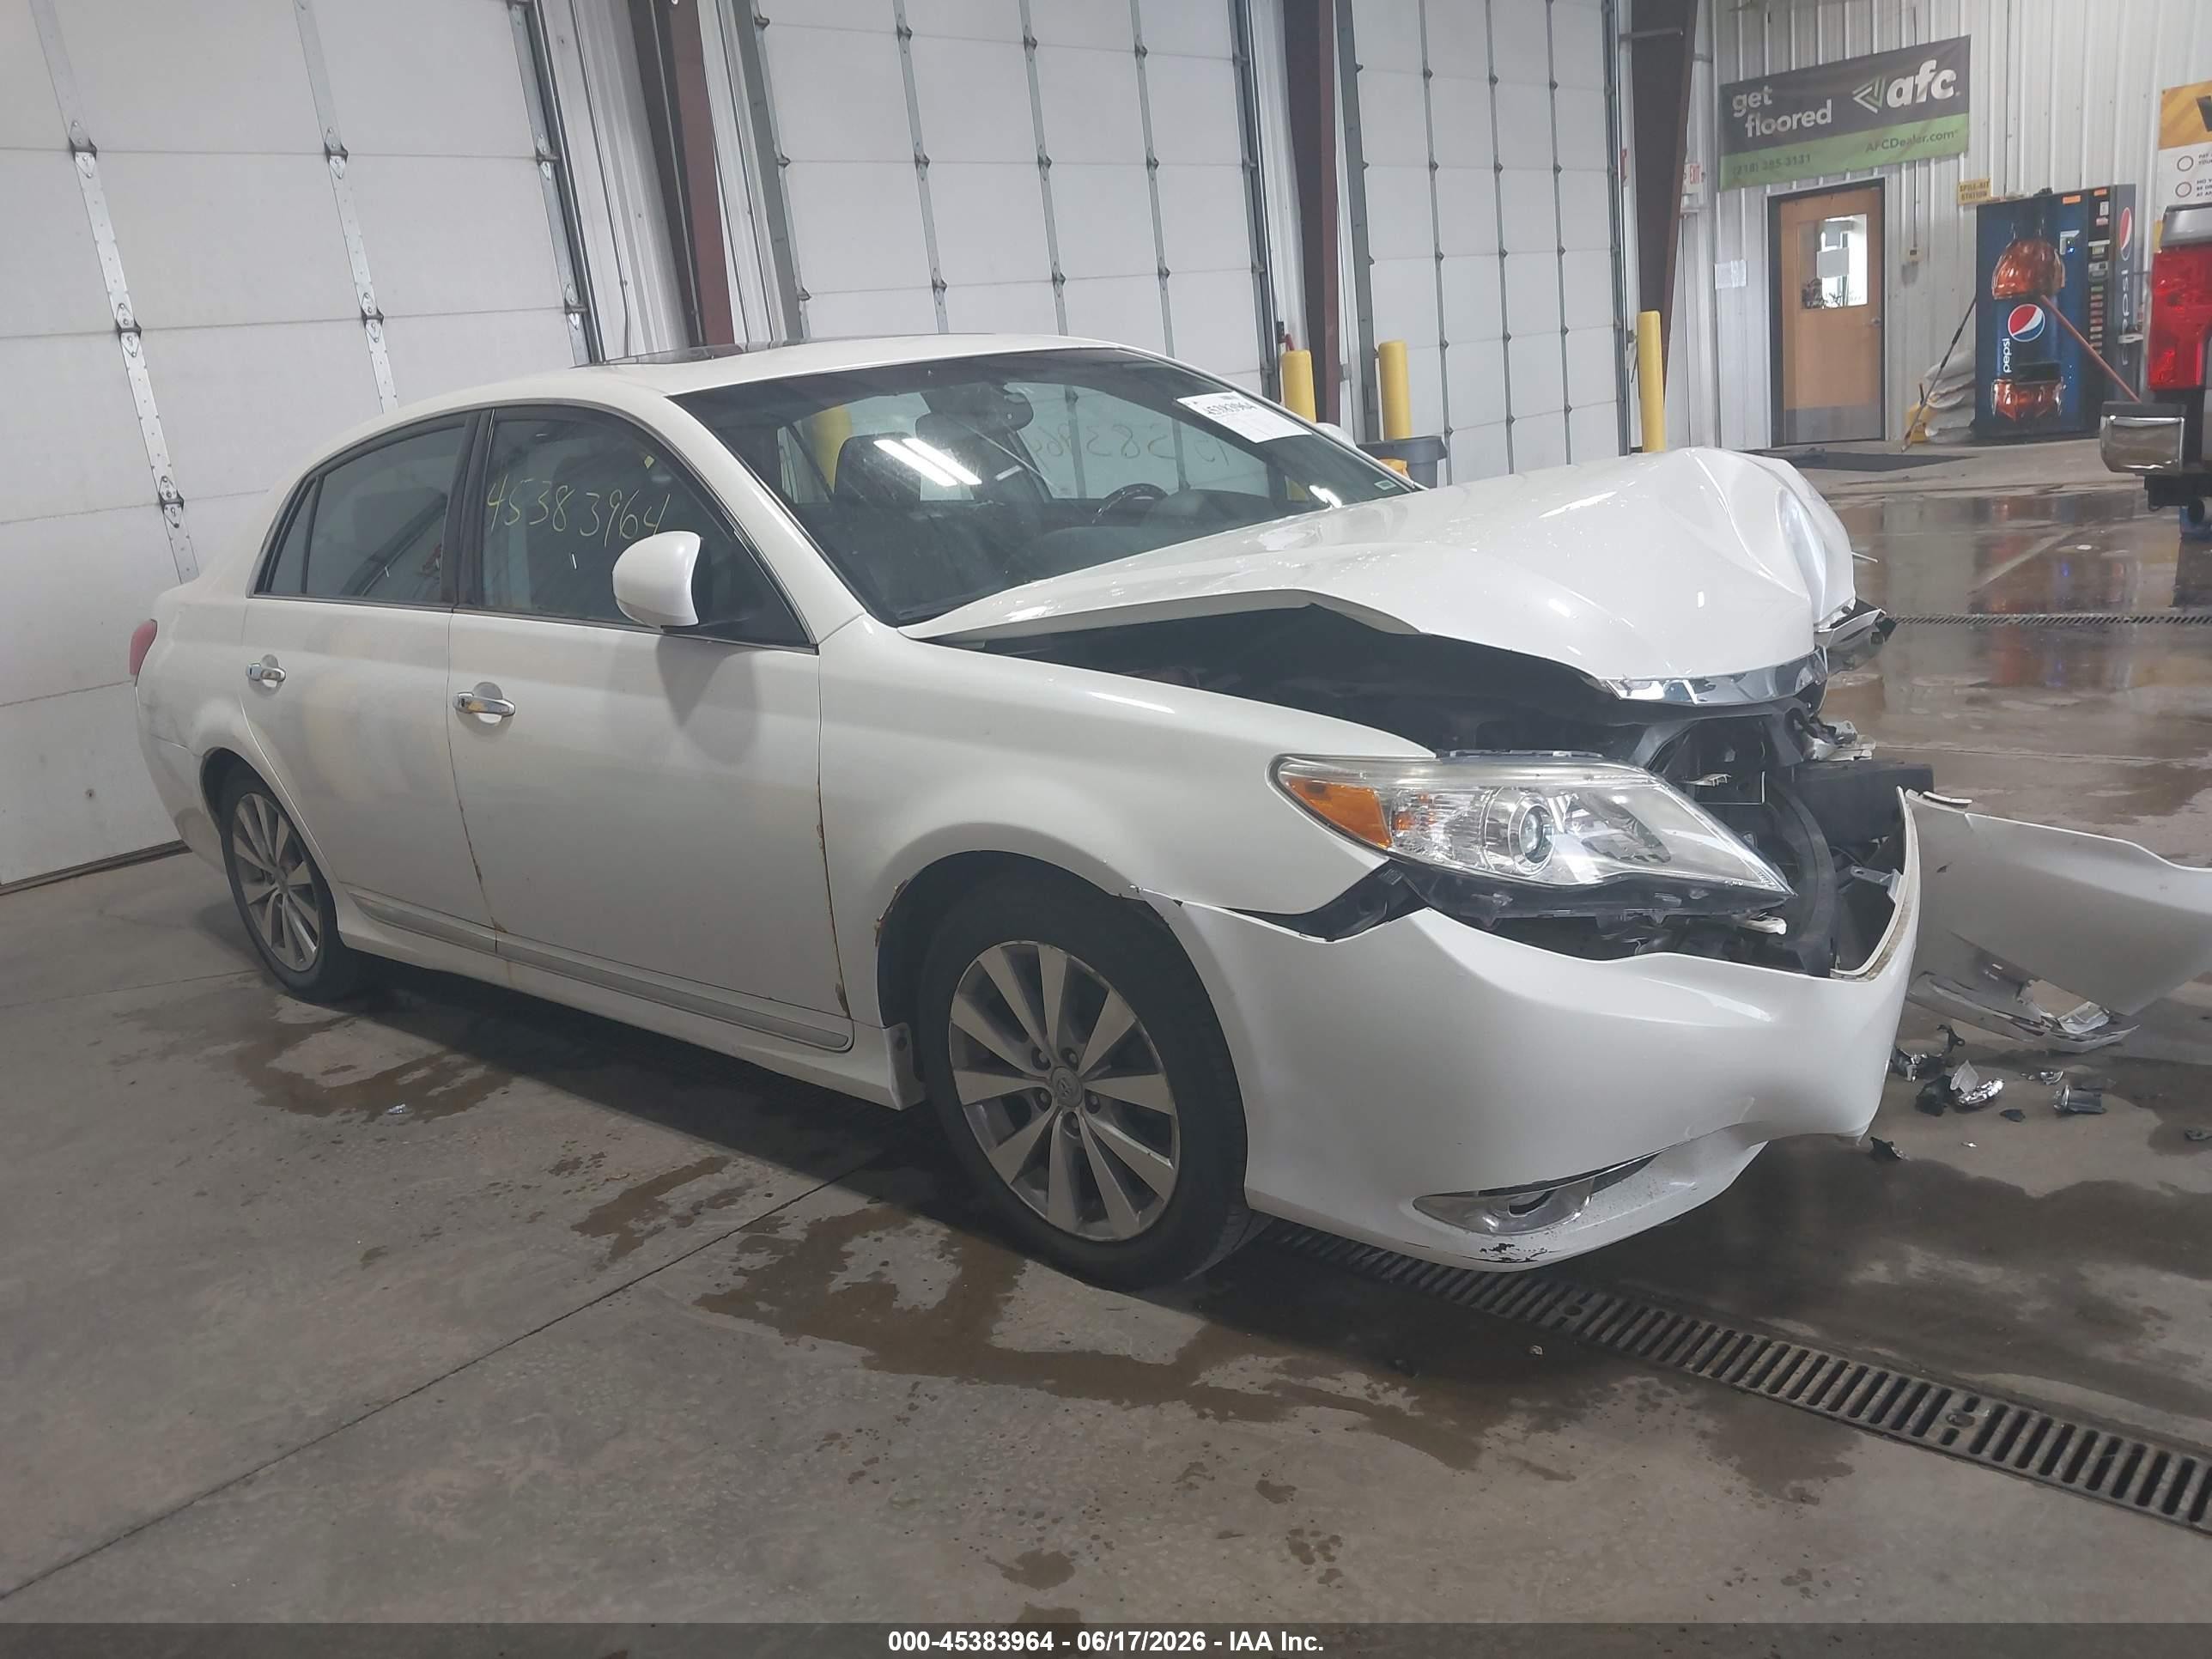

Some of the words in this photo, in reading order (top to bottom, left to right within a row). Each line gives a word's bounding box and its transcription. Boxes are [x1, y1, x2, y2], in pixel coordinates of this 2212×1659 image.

[1732, 86, 1772, 118] get
[1886, 59, 1956, 108] afc
[1745, 99, 1832, 138] floored
[2002, 338, 2013, 373] pepsi
[487, 473, 671, 547] 45383964
